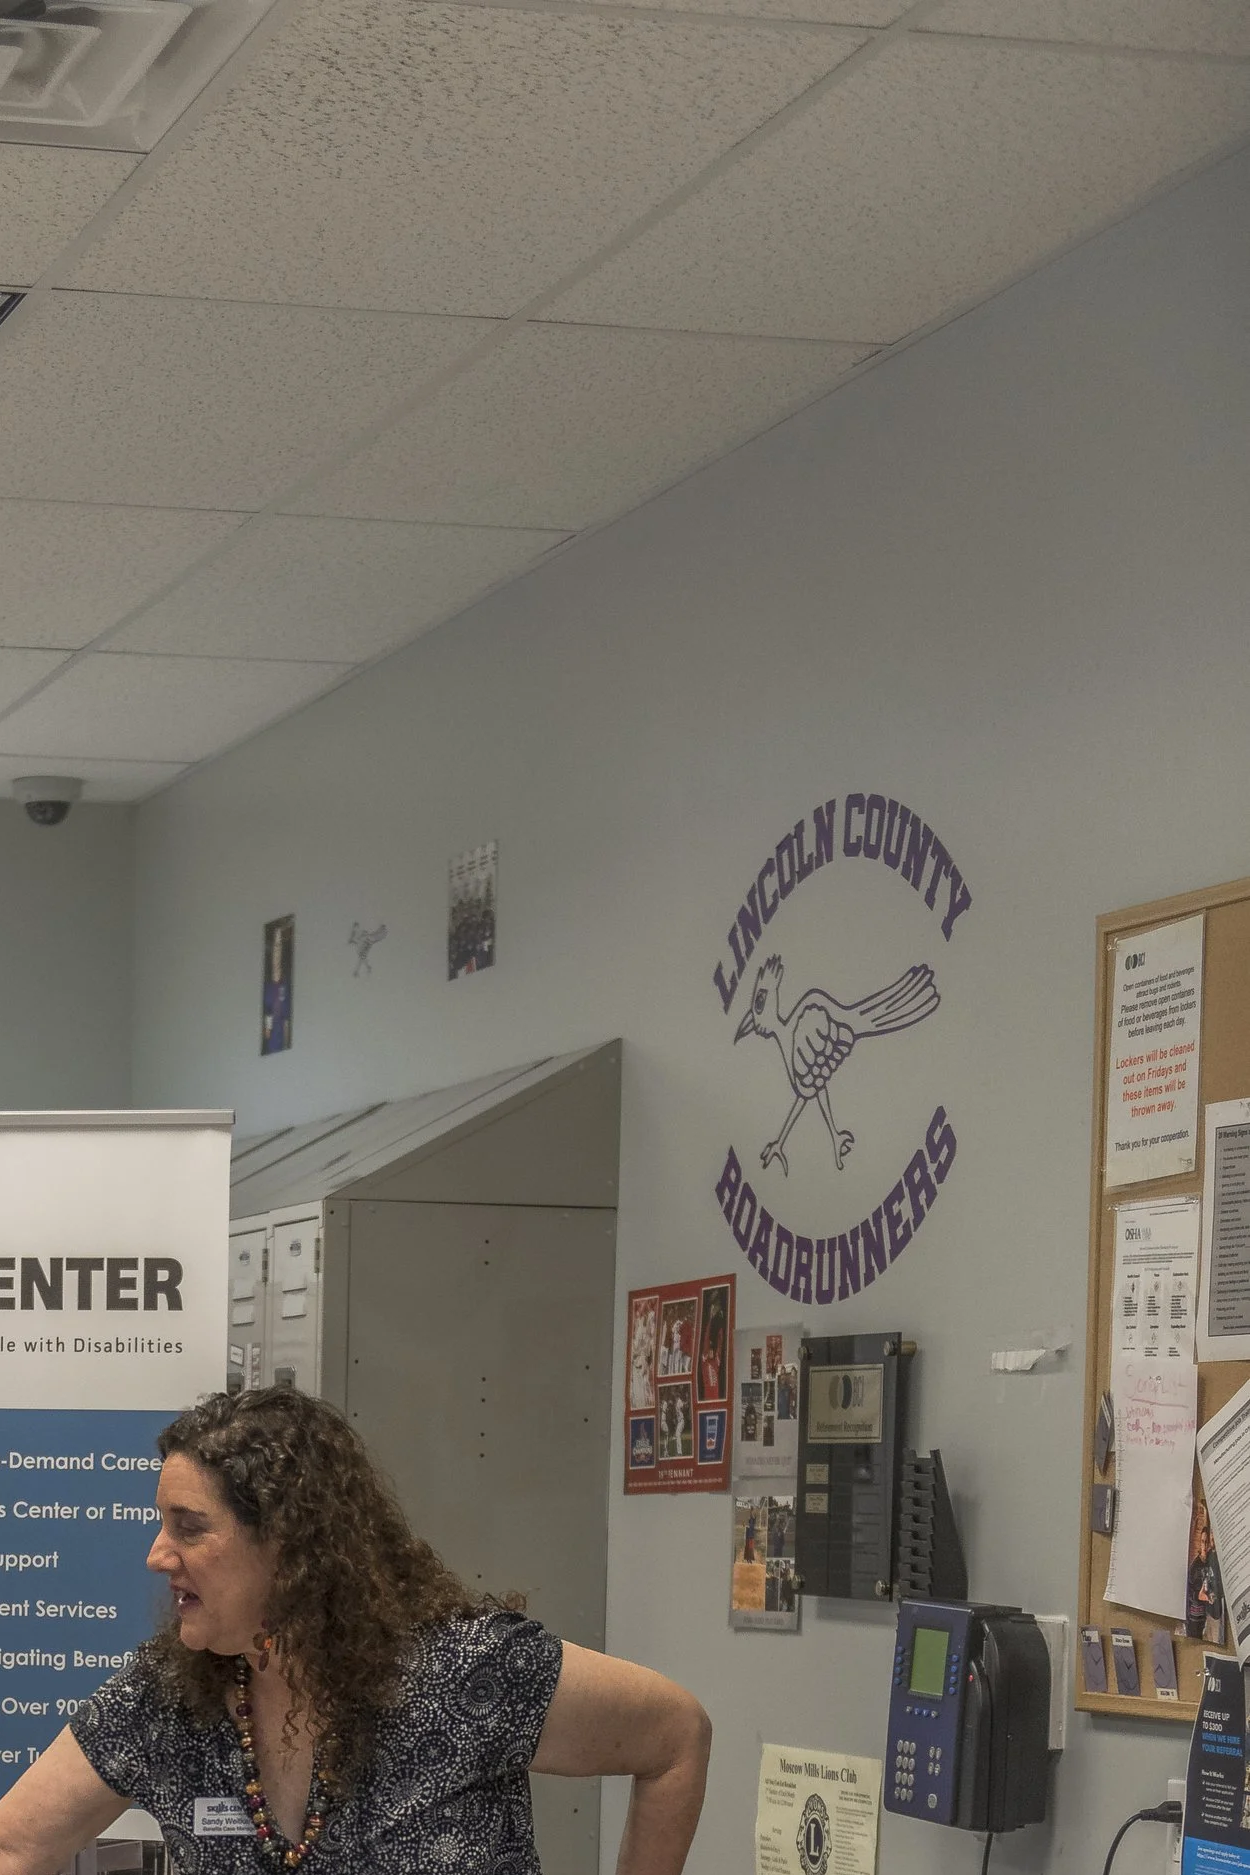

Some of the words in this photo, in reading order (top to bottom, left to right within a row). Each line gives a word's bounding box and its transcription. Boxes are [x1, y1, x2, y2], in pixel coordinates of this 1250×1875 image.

[713, 798, 836, 1015] LINCOLN
[843, 793, 972, 942] COUNTY
[1121, 1004, 1138, 1014] Please
[1139, 999, 1157, 1009] remove
[1158, 995, 1170, 1005] open
[1171, 987, 1194, 1001] containers
[1118, 1018, 1124, 1027] of
[1124, 1016, 1135, 1026] food
[1142, 1009, 1167, 1021] beverages
[1169, 1005, 1179, 1014] from
[1180, 1001, 1196, 1010] lockers
[1128, 1028, 1144, 1038] before
[1145, 1023, 1162, 1032] leaving
[1163, 1019, 1175, 1029] each
[1116, 1056, 1143, 1069] Lockers
[1146, 1049, 1157, 1060] will
[1160, 1048, 1167, 1059] be
[1170, 1041, 1194, 1057] cleaned
[1123, 1074, 1134, 1084] out
[1137, 1072, 1145, 1082] on
[1148, 1065, 1172, 1079] Fridays
[1175, 1059, 1187, 1073] and
[1122, 1090, 1142, 1102] these
[1144, 1086, 1163, 1097] items
[1165, 1080, 1176, 1091] will
[1178, 1079, 1185, 1089] be
[1131, 1104, 1155, 1117] thrown
[1115, 1141, 1130, 1152] Thank
[1131, 1140, 1140, 1151] you
[1149, 1137, 1160, 1147] your
[714, 1105, 958, 1305] ROADRUNNERS
[24, 1337, 64, 1352] with
[74, 1337, 182, 1353] Disabilities
[102, 1453, 163, 1471] Caree
[13, 1501, 79, 1519] Center
[86, 1507, 105, 1519] or
[113, 1503, 161, 1524] Empl
[36, 1600, 117, 1618] Services
[74, 1651, 134, 1668] Benef
[2, 1698, 49, 1715] Over
[1203, 1710, 1221, 1720] RECEIVE
[1222, 1712, 1230, 1721] UP
[1202, 1721, 1208, 1730] TO
[1209, 1722, 1223, 1732] $300
[780, 1759, 803, 1775] Moscow
[805, 1763, 819, 1778] Mills
[821, 1765, 839, 1781] Lions
[840, 1768, 857, 1784] Club
